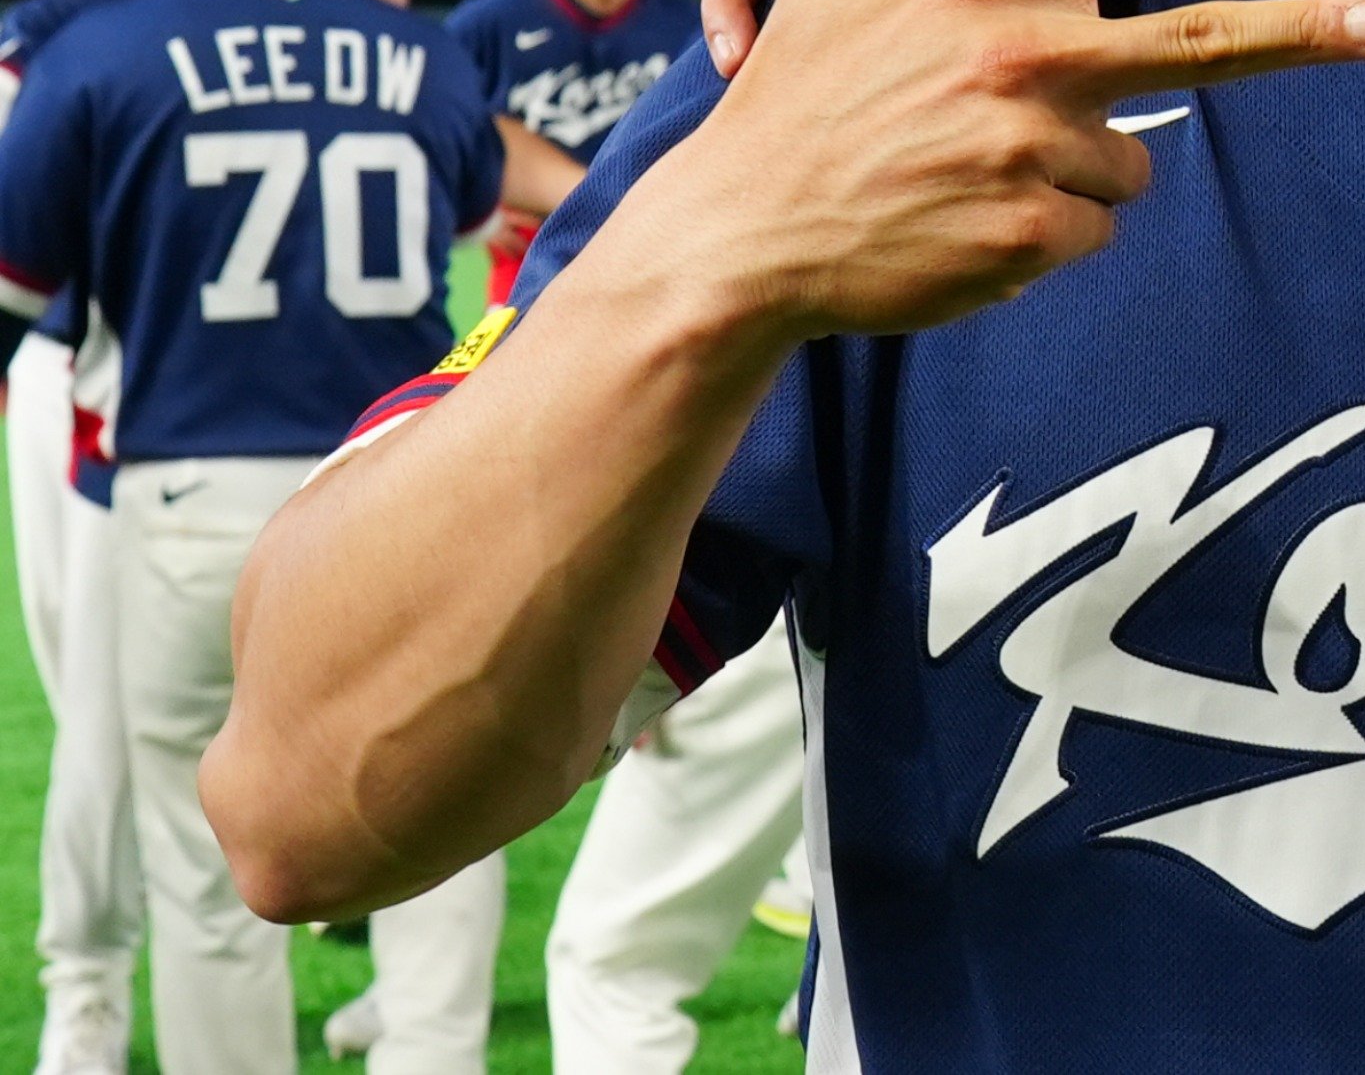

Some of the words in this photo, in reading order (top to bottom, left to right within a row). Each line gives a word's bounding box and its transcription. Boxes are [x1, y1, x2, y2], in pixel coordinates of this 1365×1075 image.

[165, 24, 315, 115] LEE
[323, 27, 426, 115] DW
[183, 129, 432, 322] 70
